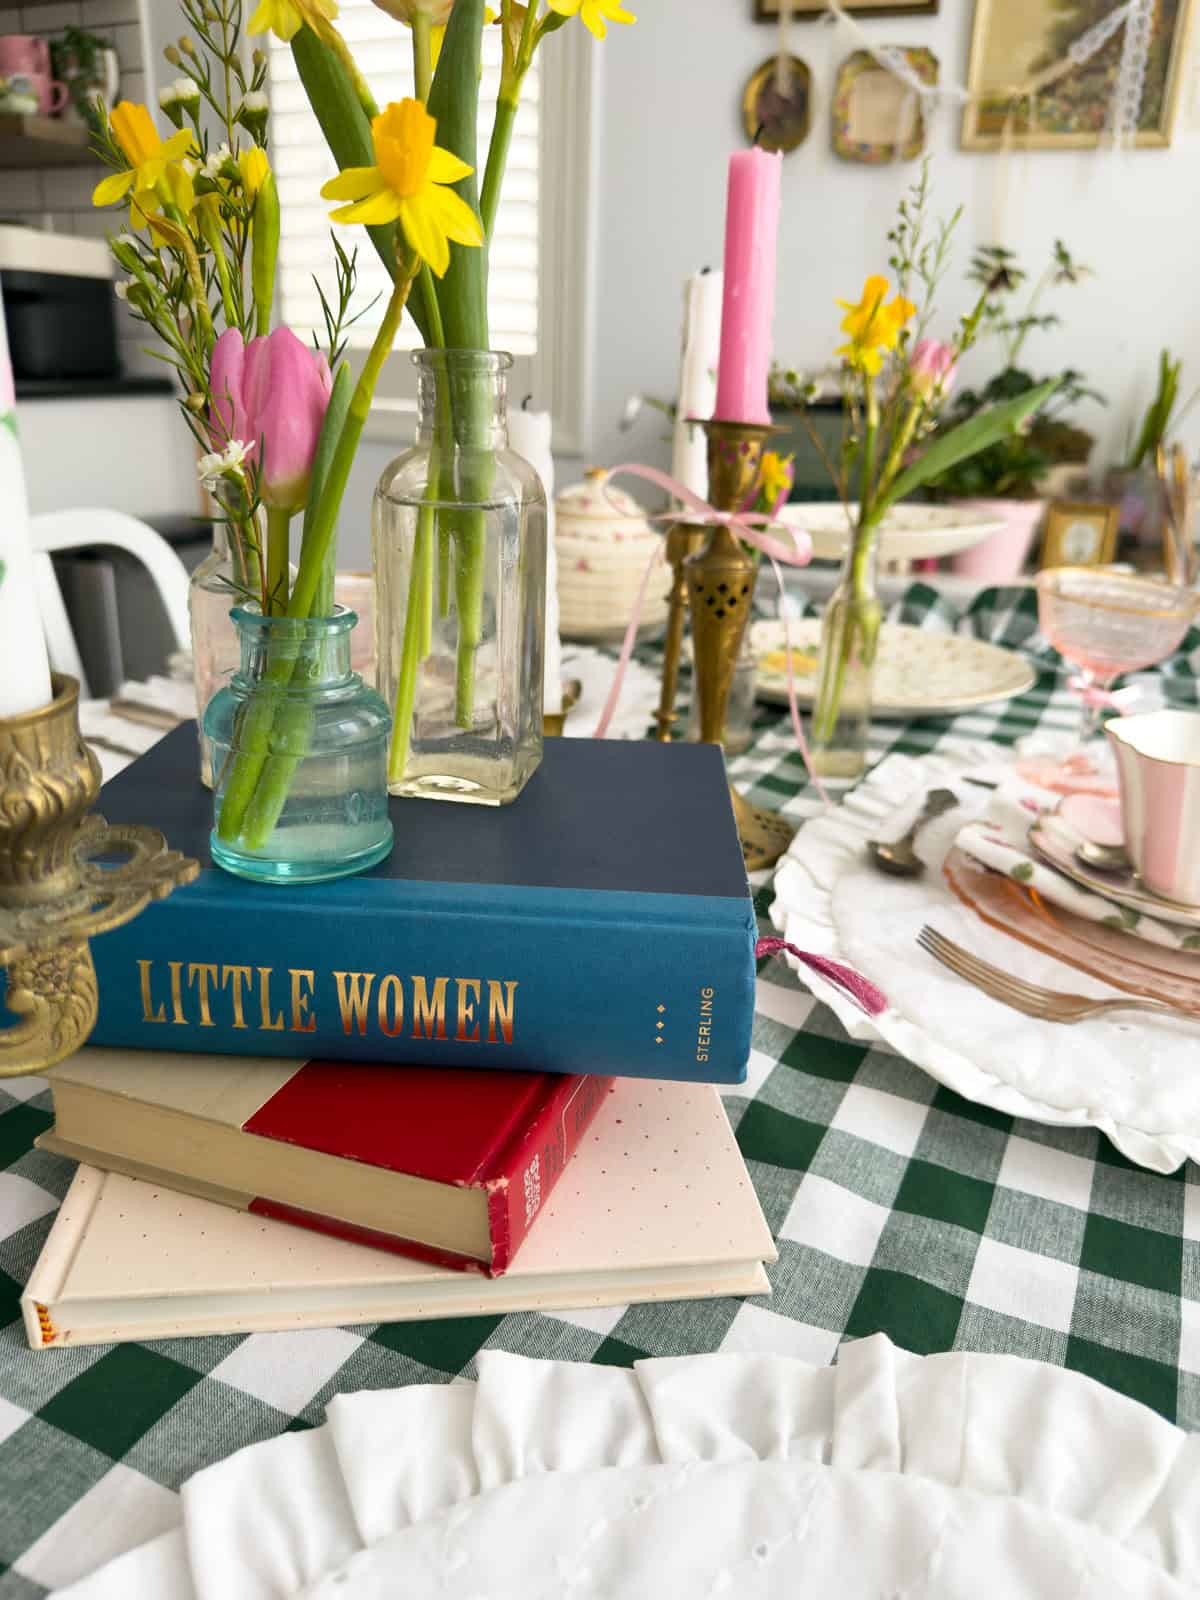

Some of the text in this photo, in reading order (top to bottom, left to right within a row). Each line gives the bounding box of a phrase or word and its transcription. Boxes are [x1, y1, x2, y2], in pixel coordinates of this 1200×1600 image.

[136, 959, 519, 1044] LITTLE WOMEN
[696, 987, 715, 1062] STERLING
